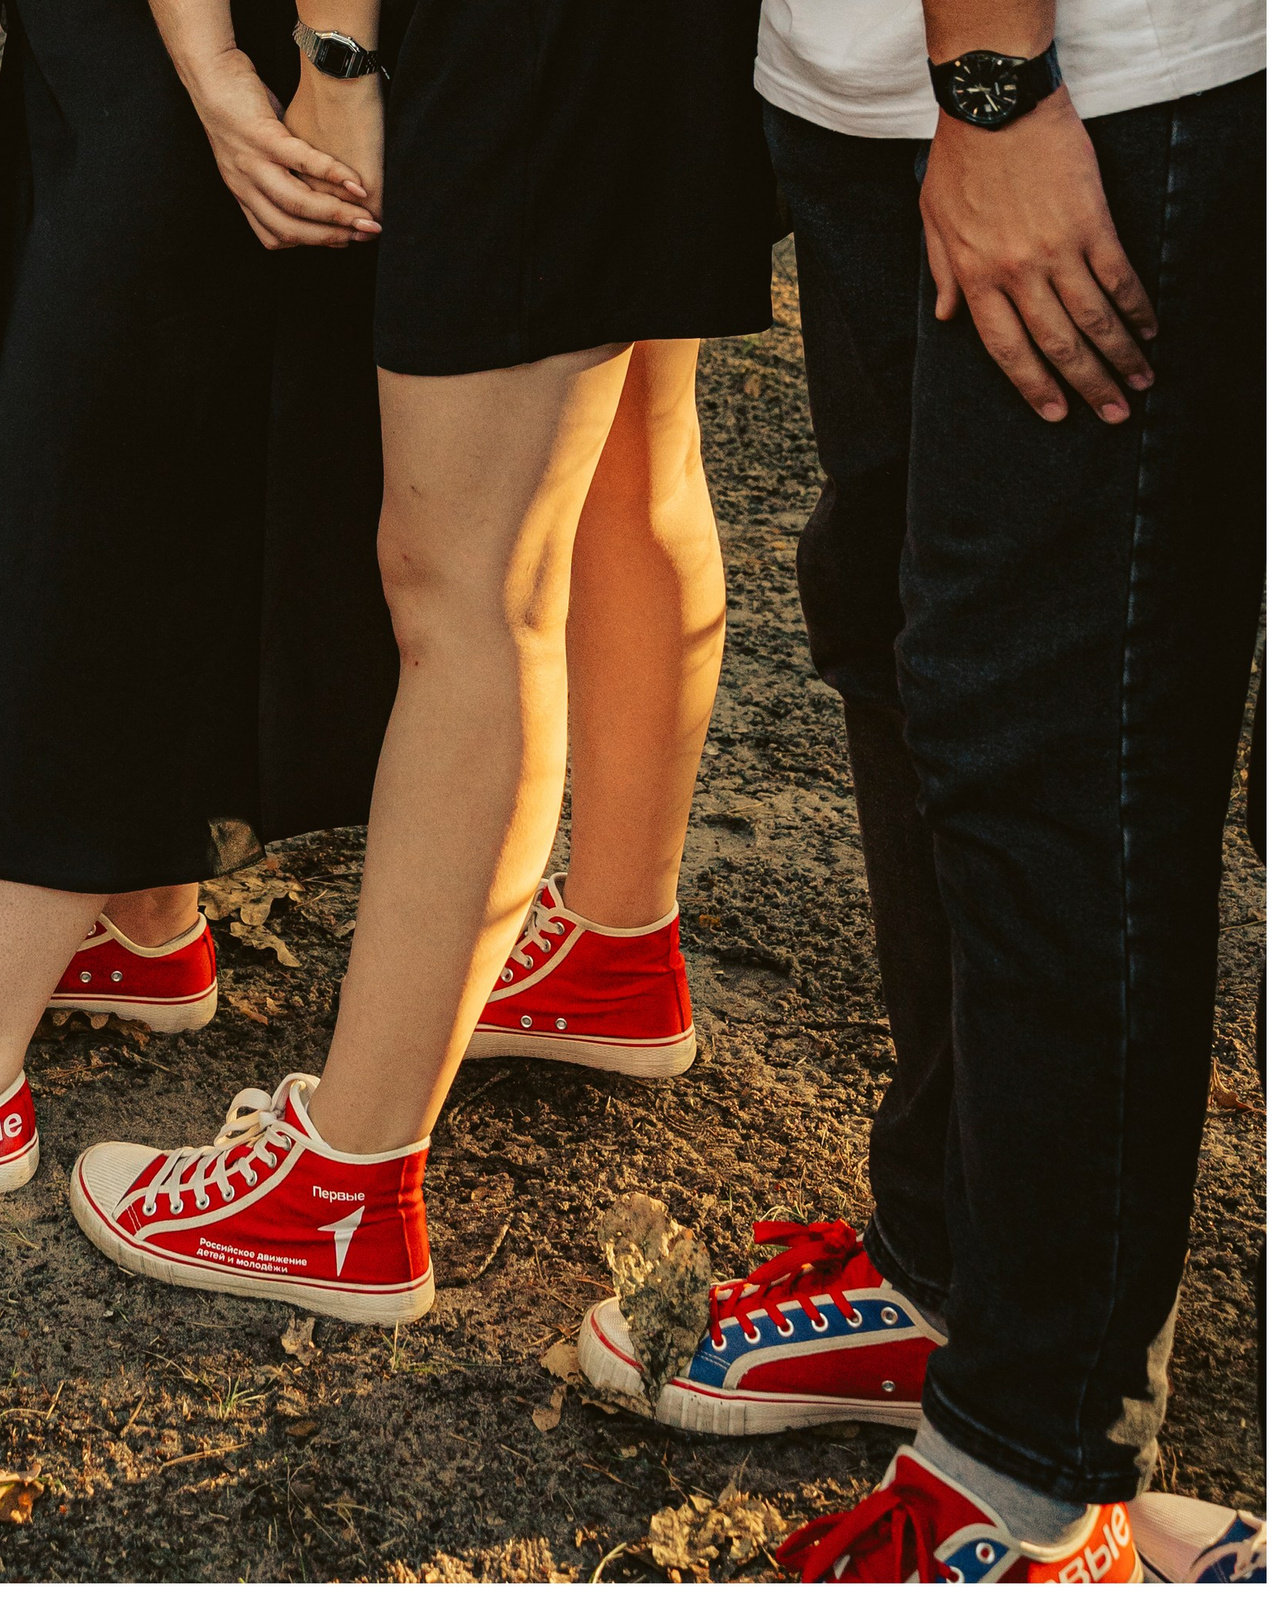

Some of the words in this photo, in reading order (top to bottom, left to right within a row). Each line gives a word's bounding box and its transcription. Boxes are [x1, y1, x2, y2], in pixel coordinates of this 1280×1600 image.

[312, 1185, 366, 1203] Первые
[196, 1248, 226, 1262] детей
[227, 1256, 234, 1264] и
[236, 1257, 288, 1273] молодёжи
[199, 1237, 255, 1259] Российское
[257, 1253, 308, 1266] движение
